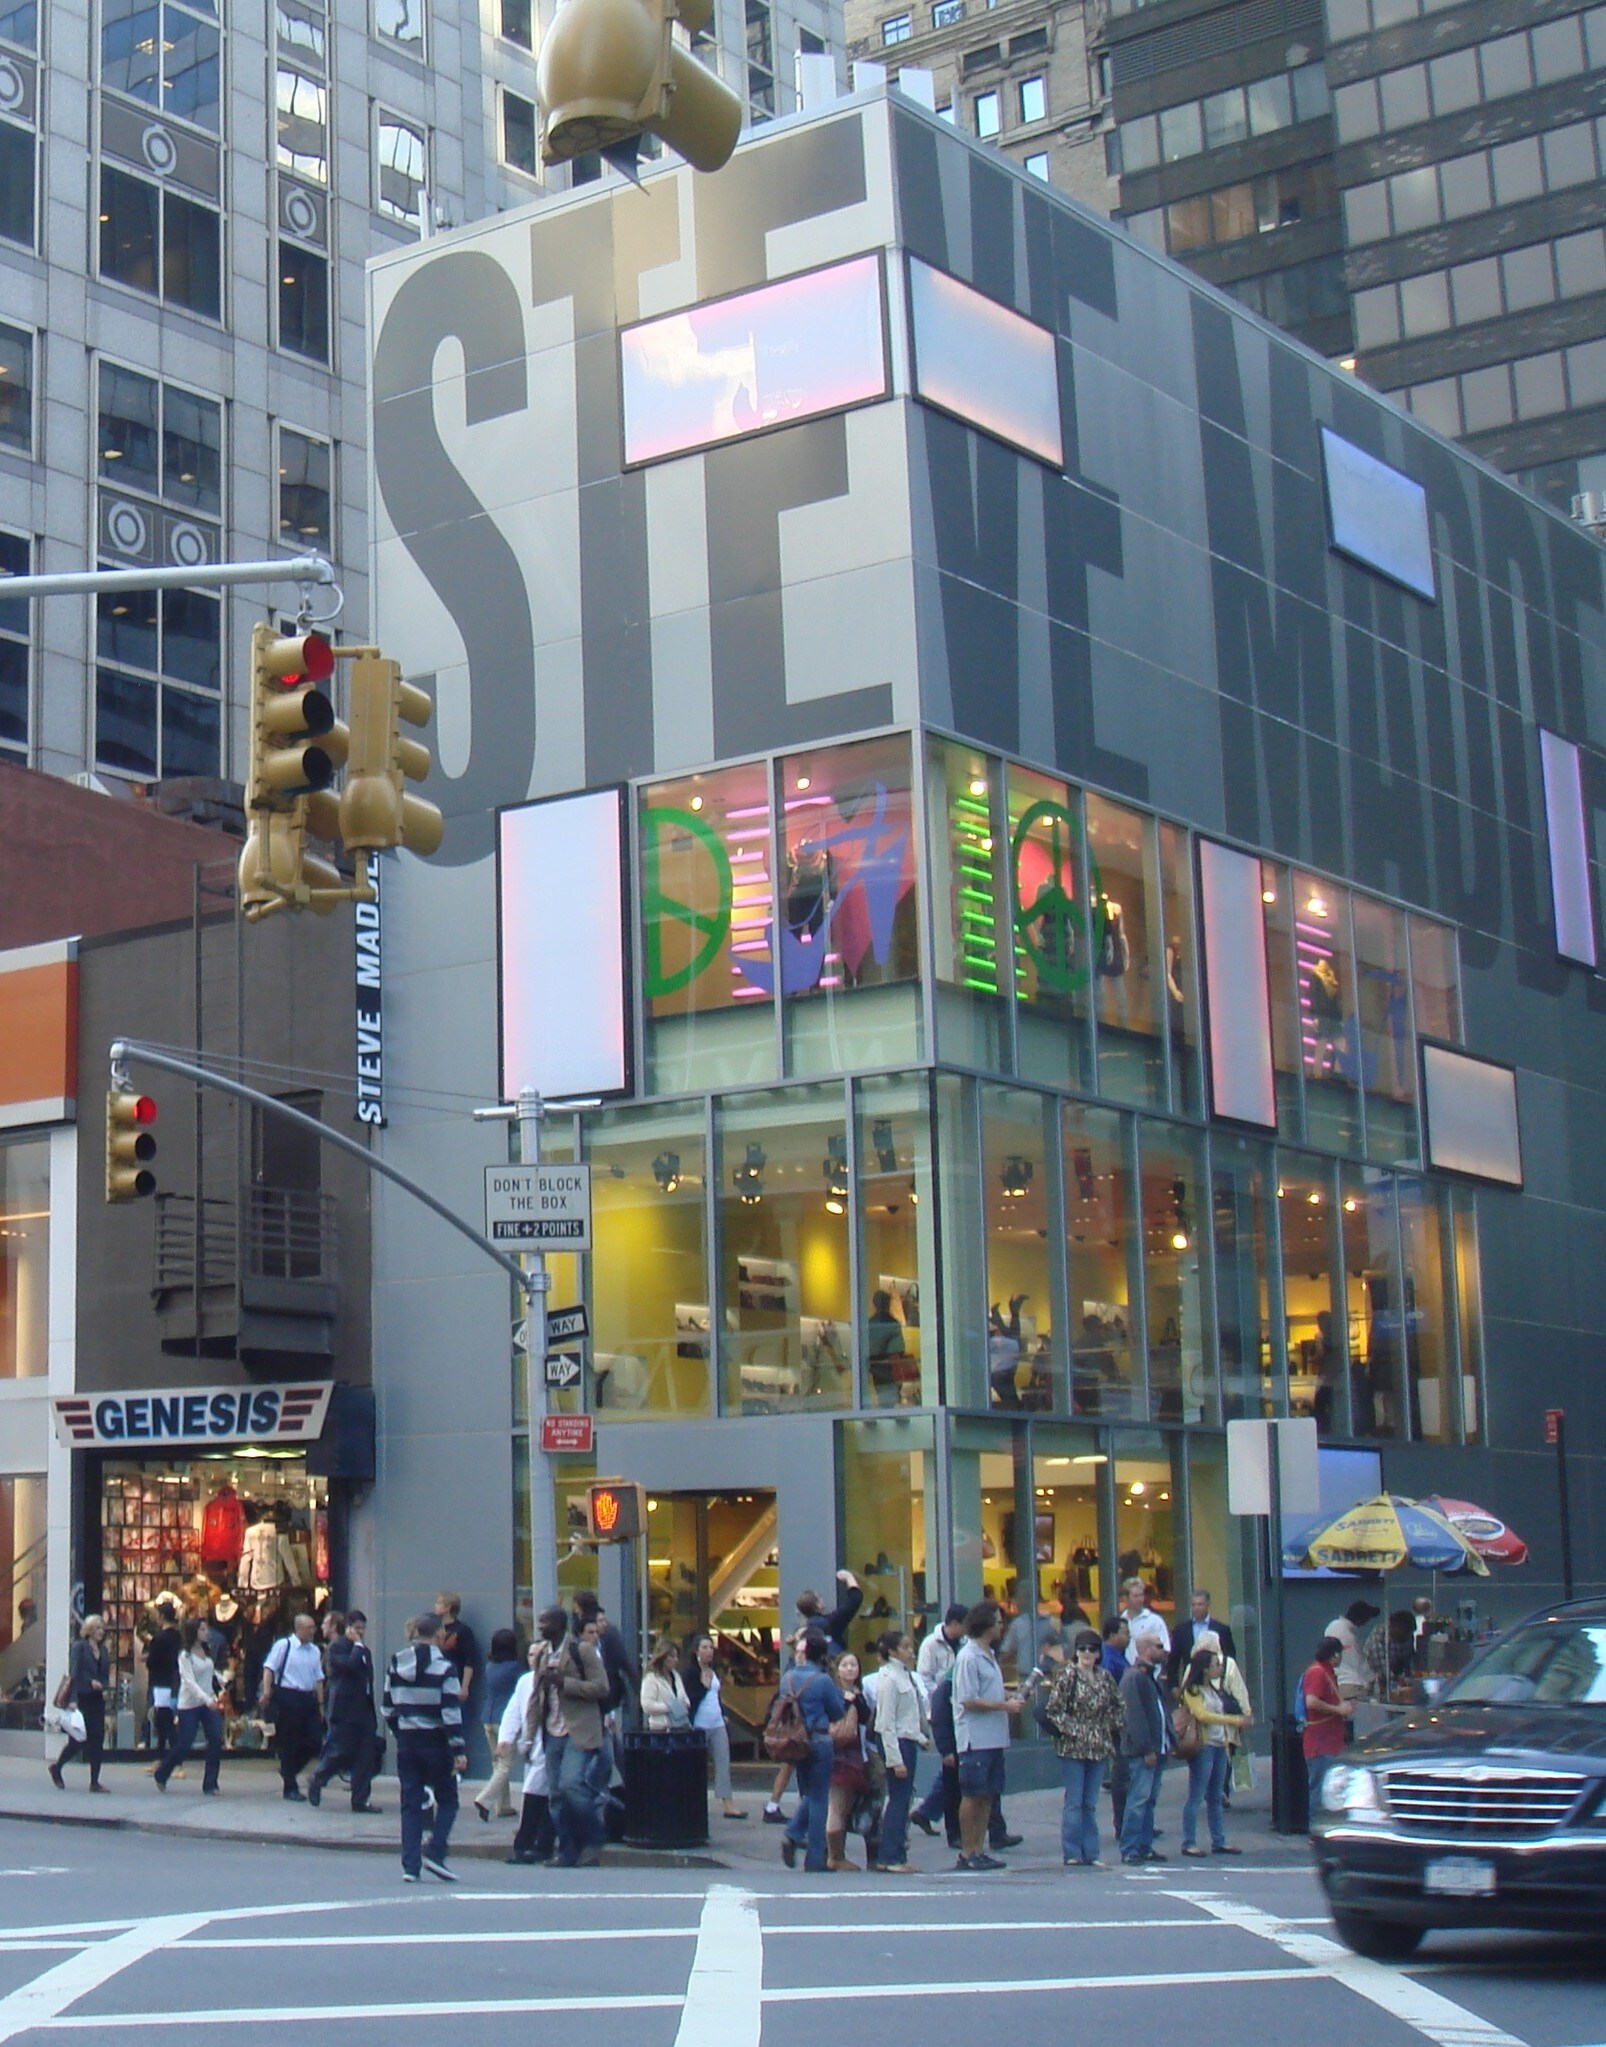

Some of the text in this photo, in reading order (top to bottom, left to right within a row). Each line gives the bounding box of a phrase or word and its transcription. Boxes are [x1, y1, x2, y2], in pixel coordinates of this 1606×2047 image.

[356, 850, 382, 1124] STEVE MAD
[493, 1177, 582, 1192] DON'T BLOCK
[510, 1195, 567, 1210] THE BOX
[496, 1222, 520, 1237] FINE
[541, 1220, 580, 1236] POINTS
[550, 1316, 576, 1335] WAY
[549, 1362, 572, 1377] WAY
[95, 1389, 280, 1440] GENESIS
